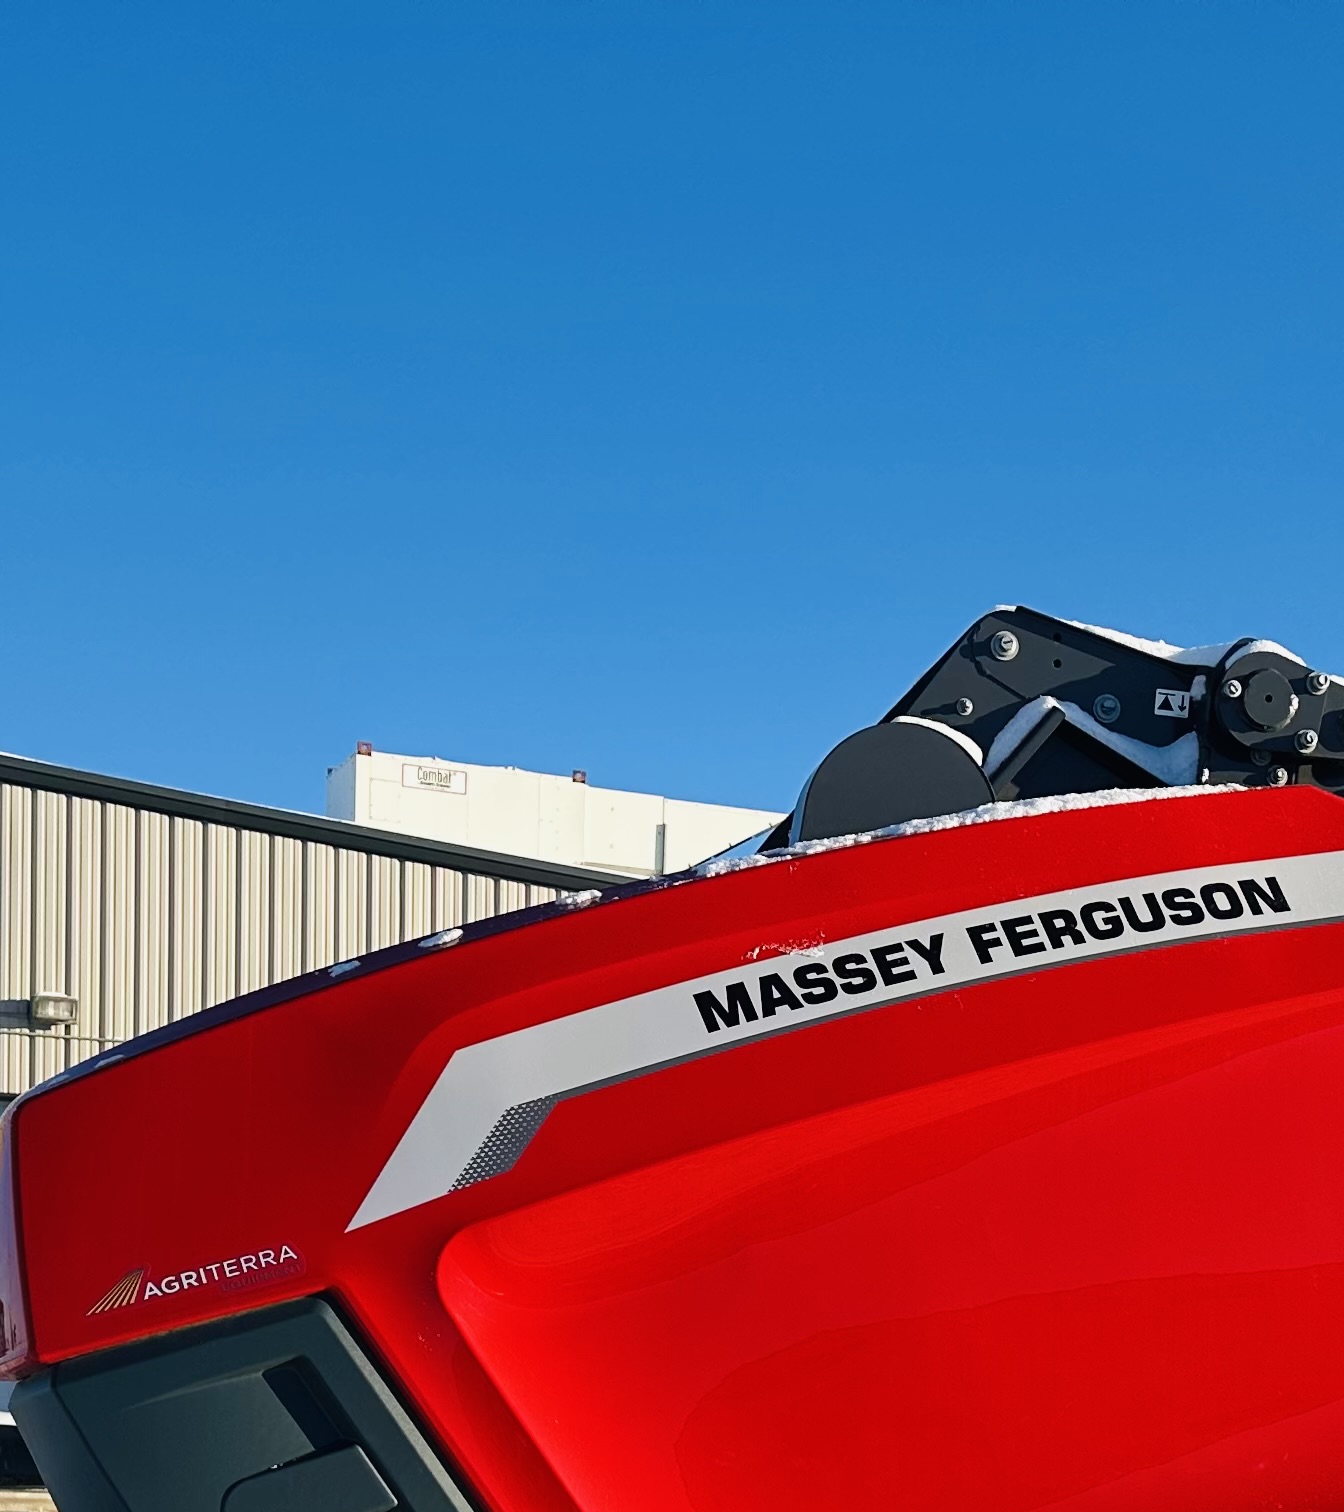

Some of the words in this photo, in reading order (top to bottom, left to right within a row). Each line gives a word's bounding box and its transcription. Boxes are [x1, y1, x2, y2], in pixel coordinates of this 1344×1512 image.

[692, 932, 947, 1034] MASSEY
[965, 876, 1292, 964] FERGUSON
[144, 1246, 298, 1301] AGRITERRA
